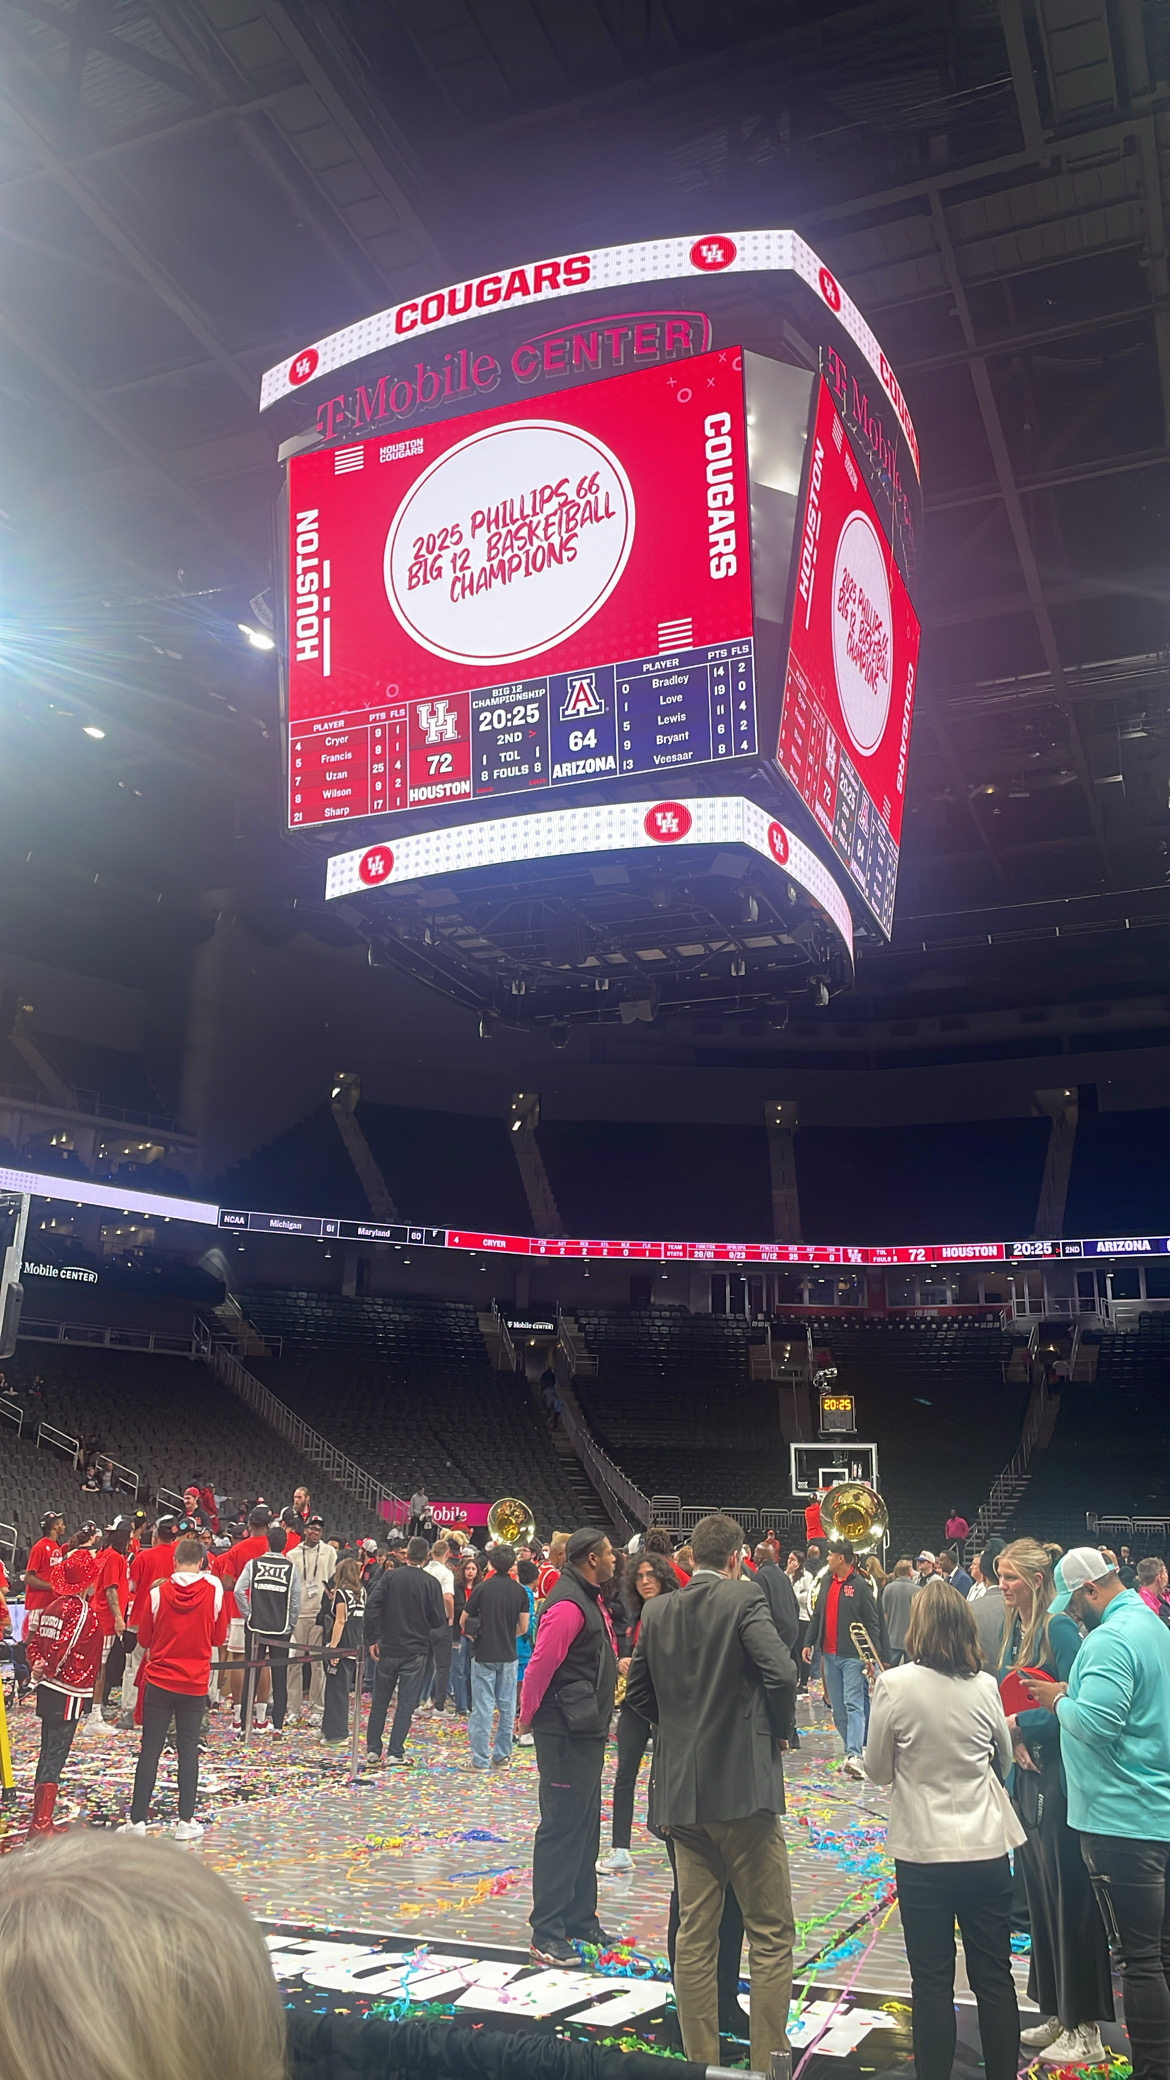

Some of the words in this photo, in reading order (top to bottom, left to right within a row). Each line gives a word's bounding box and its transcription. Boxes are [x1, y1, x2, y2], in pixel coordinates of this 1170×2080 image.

[394, 255, 591, 335] COUGARS
[511, 319, 690, 377] CENTER
[379, 438, 424, 456] HOUSTON
[379, 447, 424, 463] COUGARS
[703, 411, 738, 580] COUGARS
[413, 523, 463, 561] 2025
[471, 477, 572, 541] PHILLIPS
[575, 471, 601, 500] 66
[798, 438, 825, 602] HOUSTON
[407, 553, 442, 592] BIG
[451, 551, 471, 575] 12
[486, 490, 616, 563] BASKETBALL
[449, 535, 579, 603] CHAMPIONS
[296, 508, 319, 662] HOUSTON
[643, 658, 680, 673] PLAYER
[708, 649, 728, 660] PTS
[731, 645, 750, 656] FLS
[492, 686, 509, 698] BIG
[511, 684, 523, 694] 12
[621, 684, 630, 695] 0
[652, 675, 690, 690] Bradley
[713, 666, 725, 677] 14
[738, 662, 746, 673] 2
[472, 688, 546, 710] CHAMPIONSHIP
[659, 693, 683, 706] Love
[714, 685, 726, 696] 19
[738, 681, 747, 692] 0
[313, 719, 345, 733] PLAYER
[369, 712, 386, 722] PTS
[390, 708, 405, 719] FLS
[478, 703, 540, 732] 20:25
[623, 721, 631, 732] 5
[657, 712, 687, 726] Lewis
[738, 700, 747, 711] 4
[896, 661, 914, 795] COUGARS
[295, 741, 301, 751] 4
[325, 735, 349, 748] Cryer
[497, 732, 523, 745] 2ND
[568, 728, 597, 752] 64
[623, 740, 631, 751] 9
[656, 731, 690, 746] Bryant
[717, 724, 725, 735] 6
[739, 720, 748, 731] 2
[295, 758, 301, 768] 5
[321, 751, 352, 764] Francis
[426, 752, 453, 776] 72
[499, 750, 520, 763] TOL
[552, 755, 616, 780] ARIZONA
[622, 760, 634, 771] 13
[653, 750, 694, 766] Veesaar
[718, 744, 726, 754] 8
[740, 740, 749, 751] 4
[295, 777, 301, 786] 7
[325, 770, 348, 781] Uzan
[372, 763, 384, 774] 25
[394, 760, 401, 770] 4
[481, 770, 489, 782] 8
[493, 764, 529, 779] FOULS
[534, 762, 542, 773] 8
[295, 794, 301, 804] 8
[322, 787, 352, 799] Wilson
[395, 778, 401, 788] 2
[409, 779, 471, 803] HOUSTON
[823, 780, 831, 807] 72
[293, 812, 303, 822] 21
[324, 806, 350, 820] Sharp
[374, 800, 383, 810] 17
[224, 1215, 245, 1225] NCAA
[269, 1219, 302, 1231] Michigan
[357, 1227, 390, 1238] Maryland
[453, 1236, 459, 1244] 4
[483, 1238, 506, 1248] CRYER
[908, 1249, 925, 1261] 72
[942, 1246, 997, 1258] HOUSTON
[1013, 1242, 1052, 1255] 20:25
[1097, 1240, 1151, 1252] ARIZONA
[60, 1270, 95, 1282] CENTER
[824, 1399, 851, 1411] 20:25
